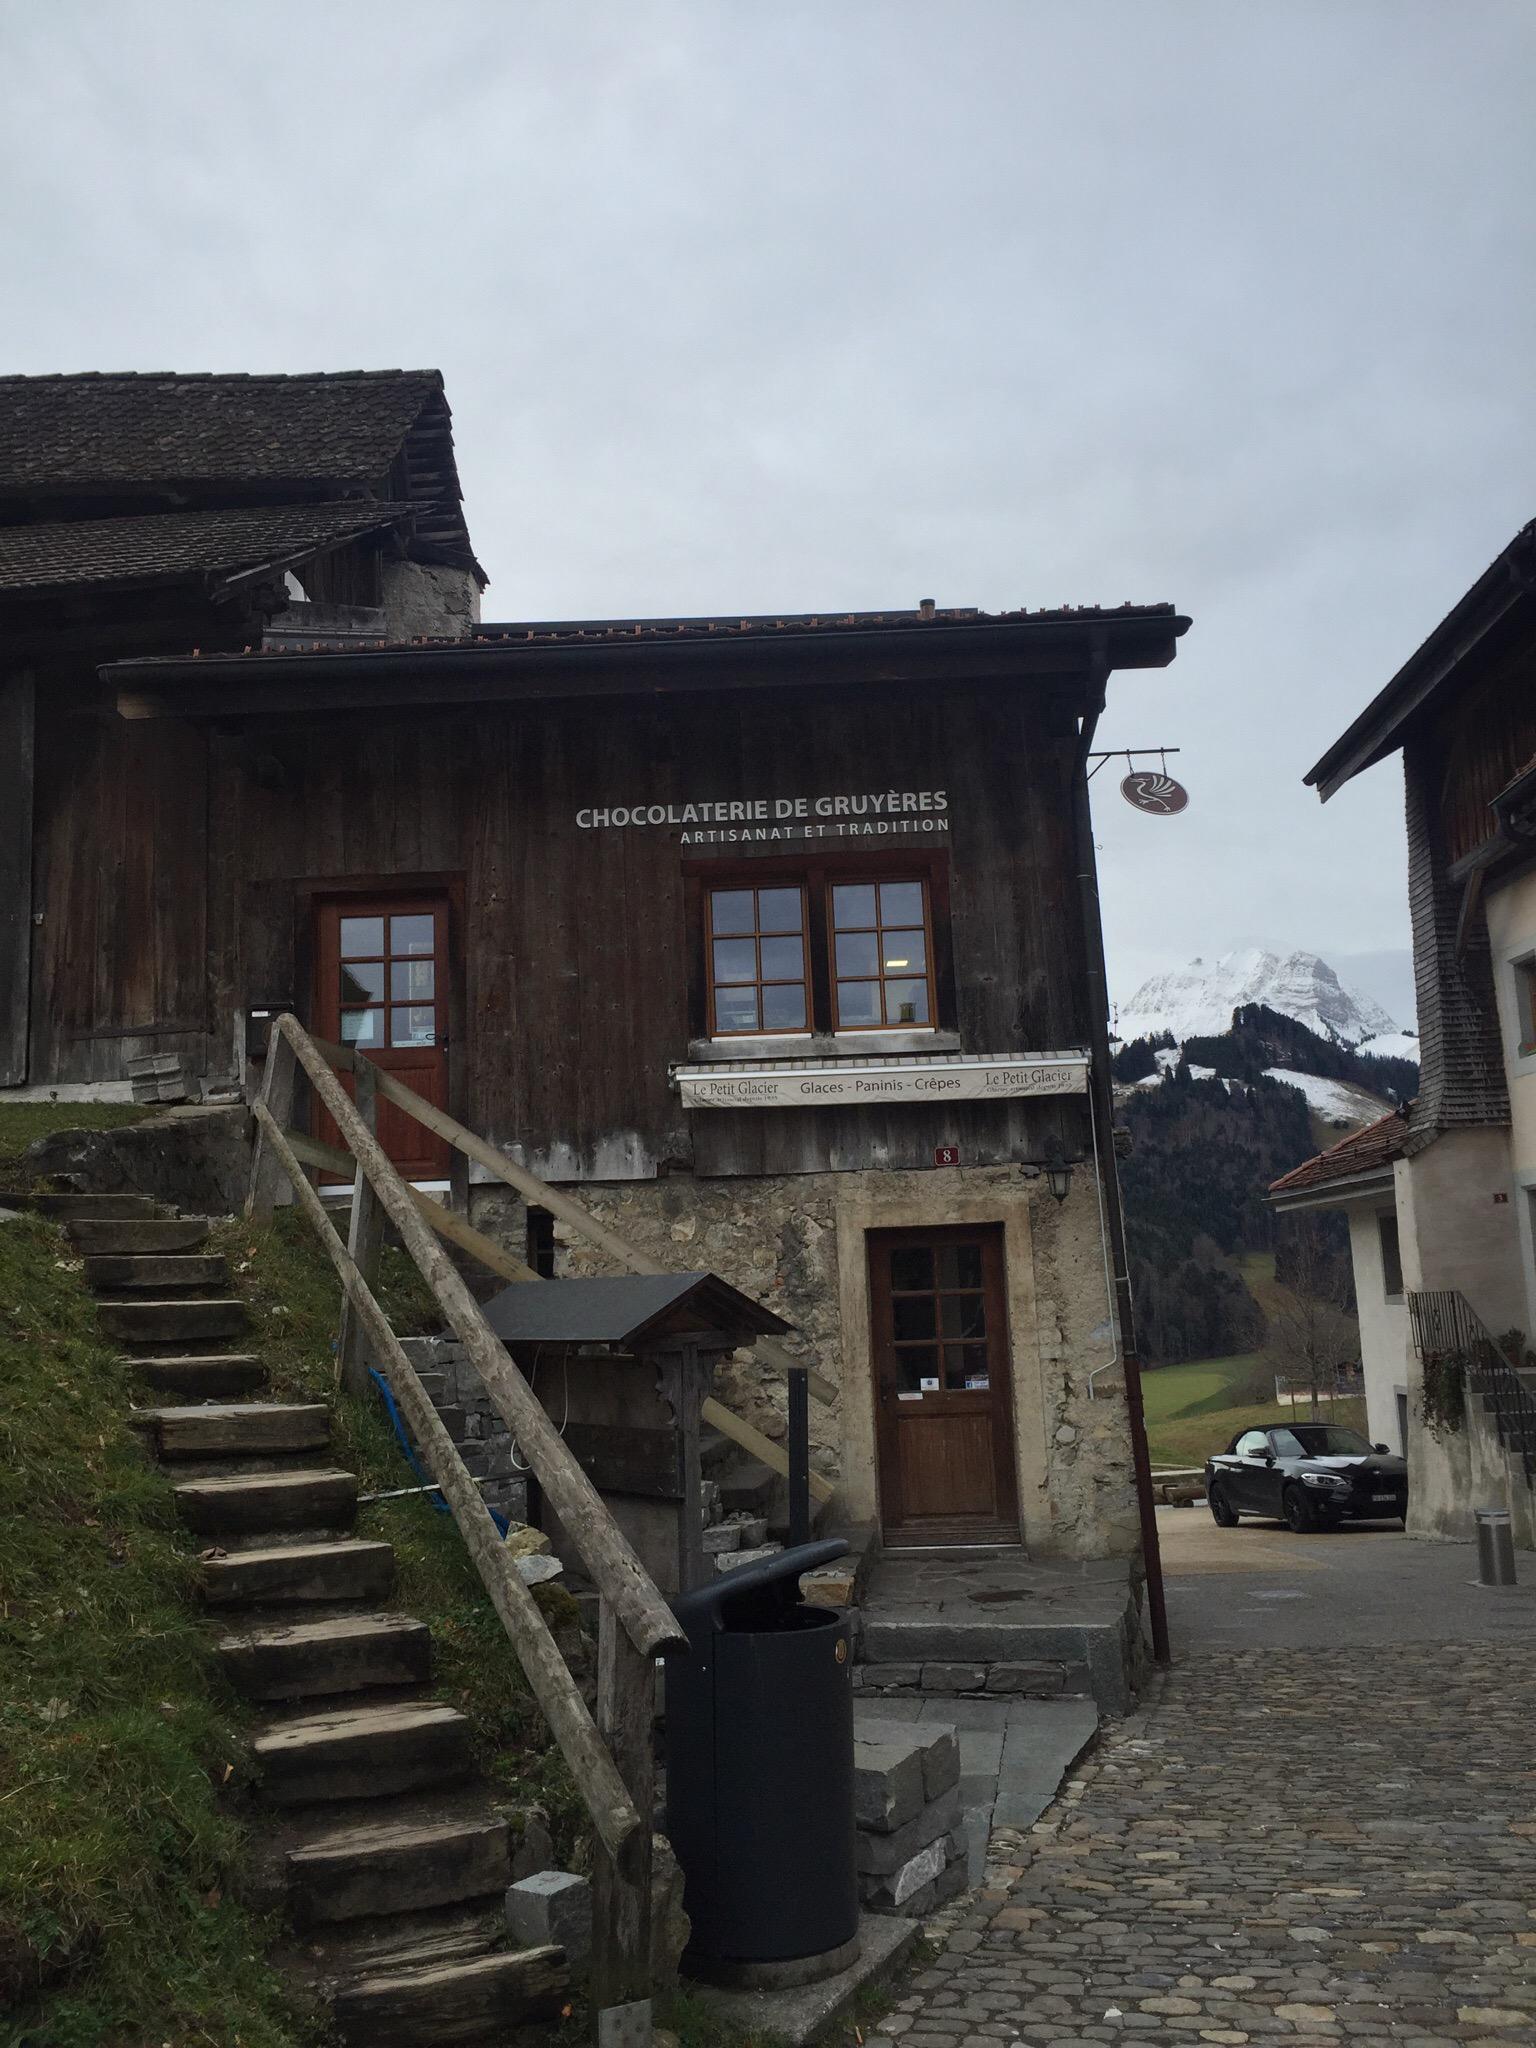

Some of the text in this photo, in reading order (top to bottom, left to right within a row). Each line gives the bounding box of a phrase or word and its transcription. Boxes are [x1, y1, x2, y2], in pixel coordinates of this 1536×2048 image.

[576, 790, 948, 829] CHOCOLATERIE DE GRUYÈRES
[680, 818, 948, 844] ARTISANAT ET TRADITION
[985, 1069, 1072, 1085] Le Petit Glacier
[693, 1080, 778, 1096] Le Petit Glacier
[800, 1082, 844, 1094] Glaces
[855, 1079, 903, 1092] Paninis
[914, 1077, 961, 1092] Crêpes
[943, 1149, 952, 1163] 8
